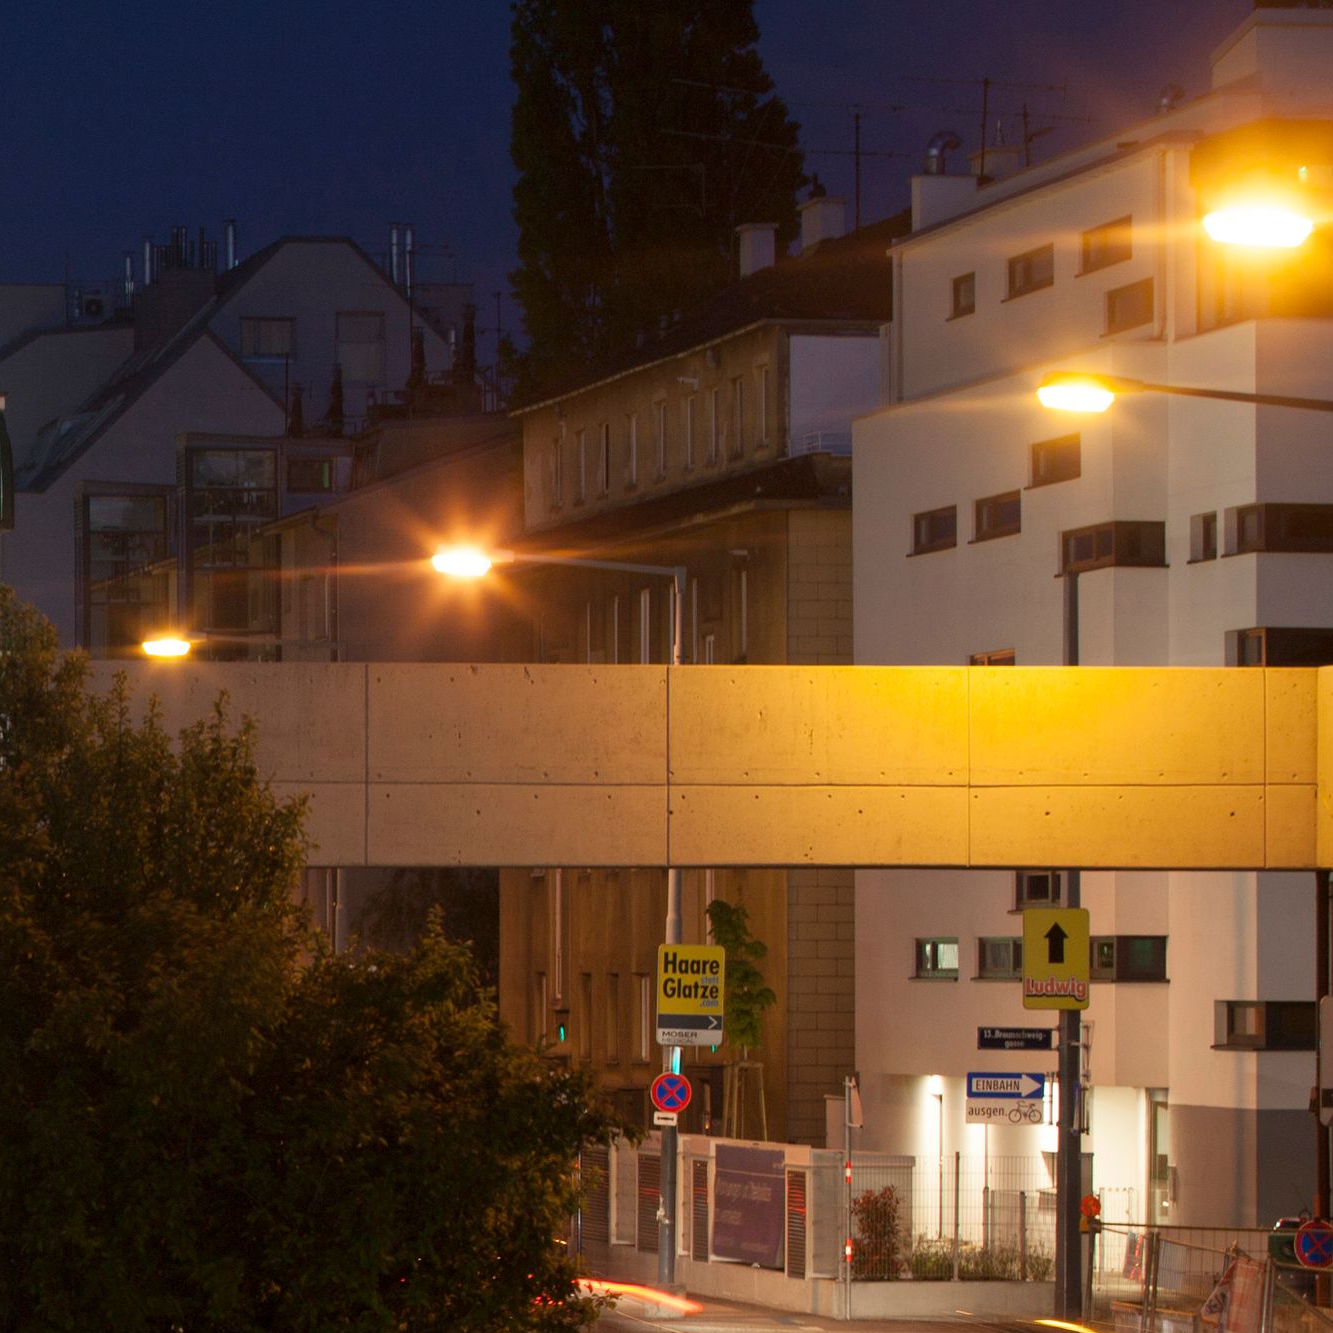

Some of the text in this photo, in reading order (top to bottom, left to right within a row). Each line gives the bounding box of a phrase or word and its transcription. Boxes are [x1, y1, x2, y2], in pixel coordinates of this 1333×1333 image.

[663, 952, 720, 975] Haare
[663, 977, 719, 999] Glatze
[1025, 976, 1087, 1001] Ludwig
[662, 1031, 698, 1039] MOSER
[975, 1079, 1020, 1091] EINBAHN
[968, 1106, 1009, 1119] ausgen.
